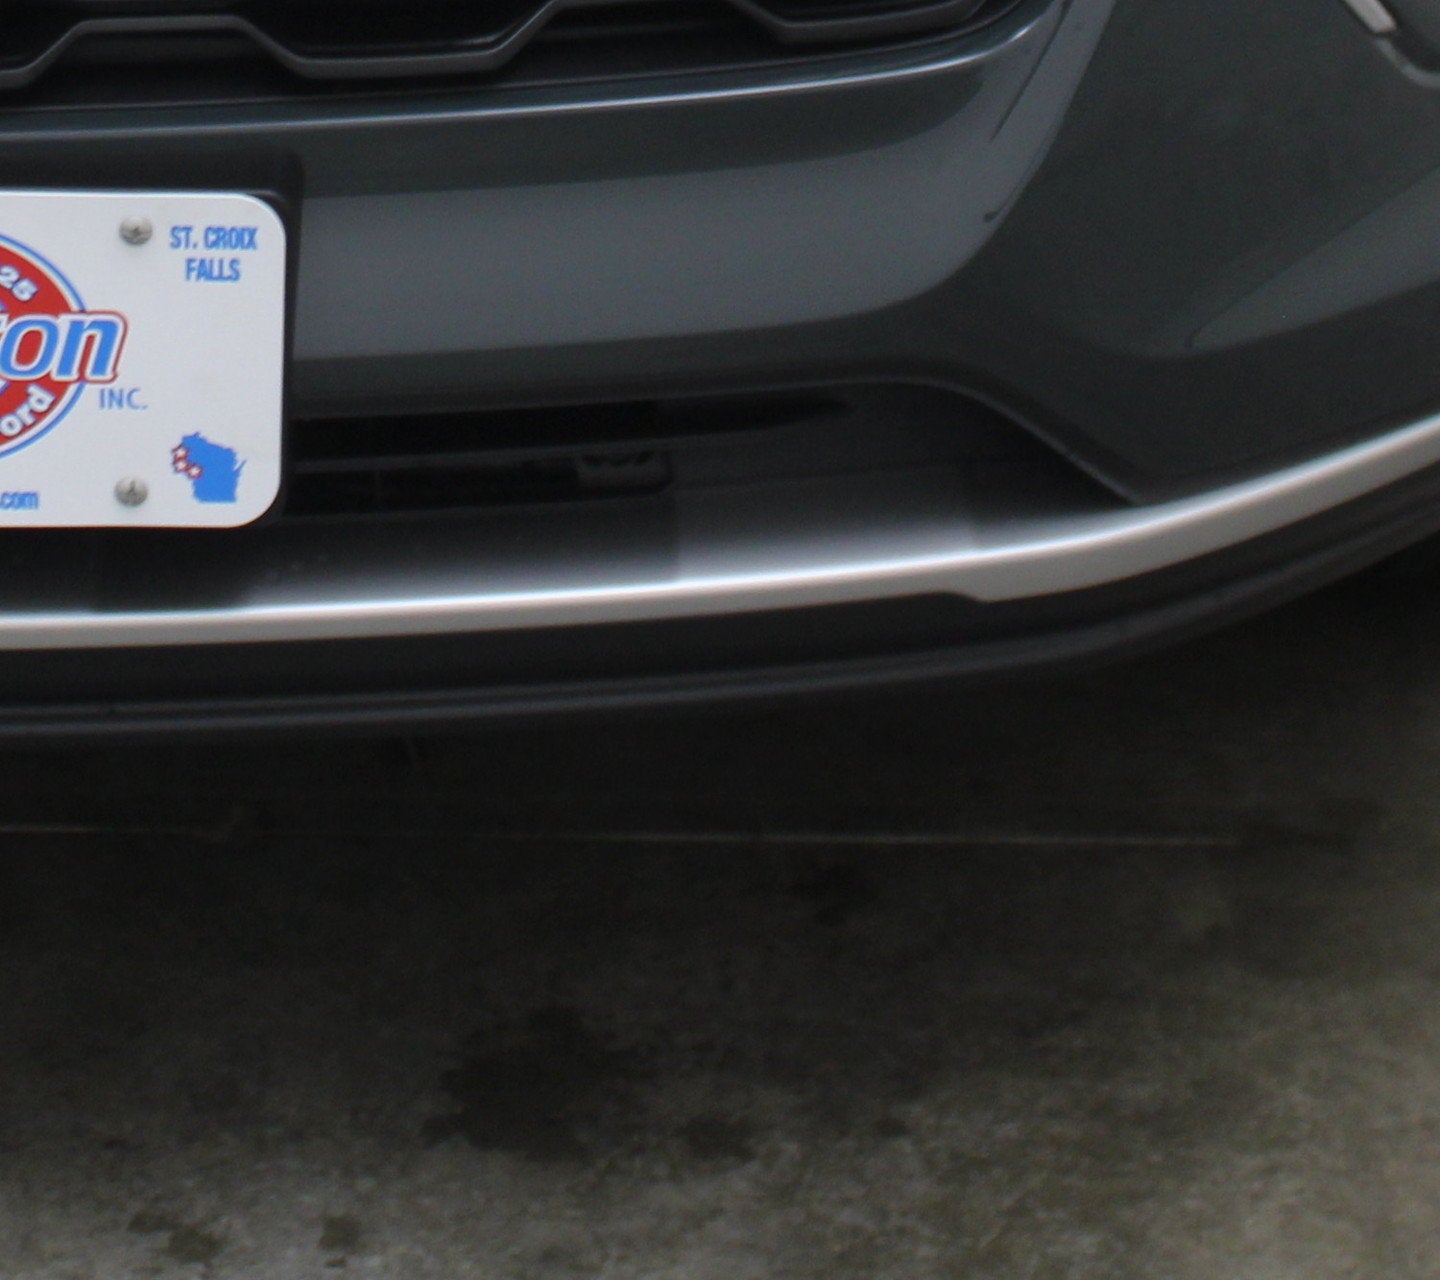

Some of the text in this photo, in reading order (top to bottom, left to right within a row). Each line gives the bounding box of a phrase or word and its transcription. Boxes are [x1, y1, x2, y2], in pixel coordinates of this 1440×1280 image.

[170, 226, 257, 251] ST. CROIX
[185, 257, 241, 282] FALLS
[99, 389, 148, 411] INC.
